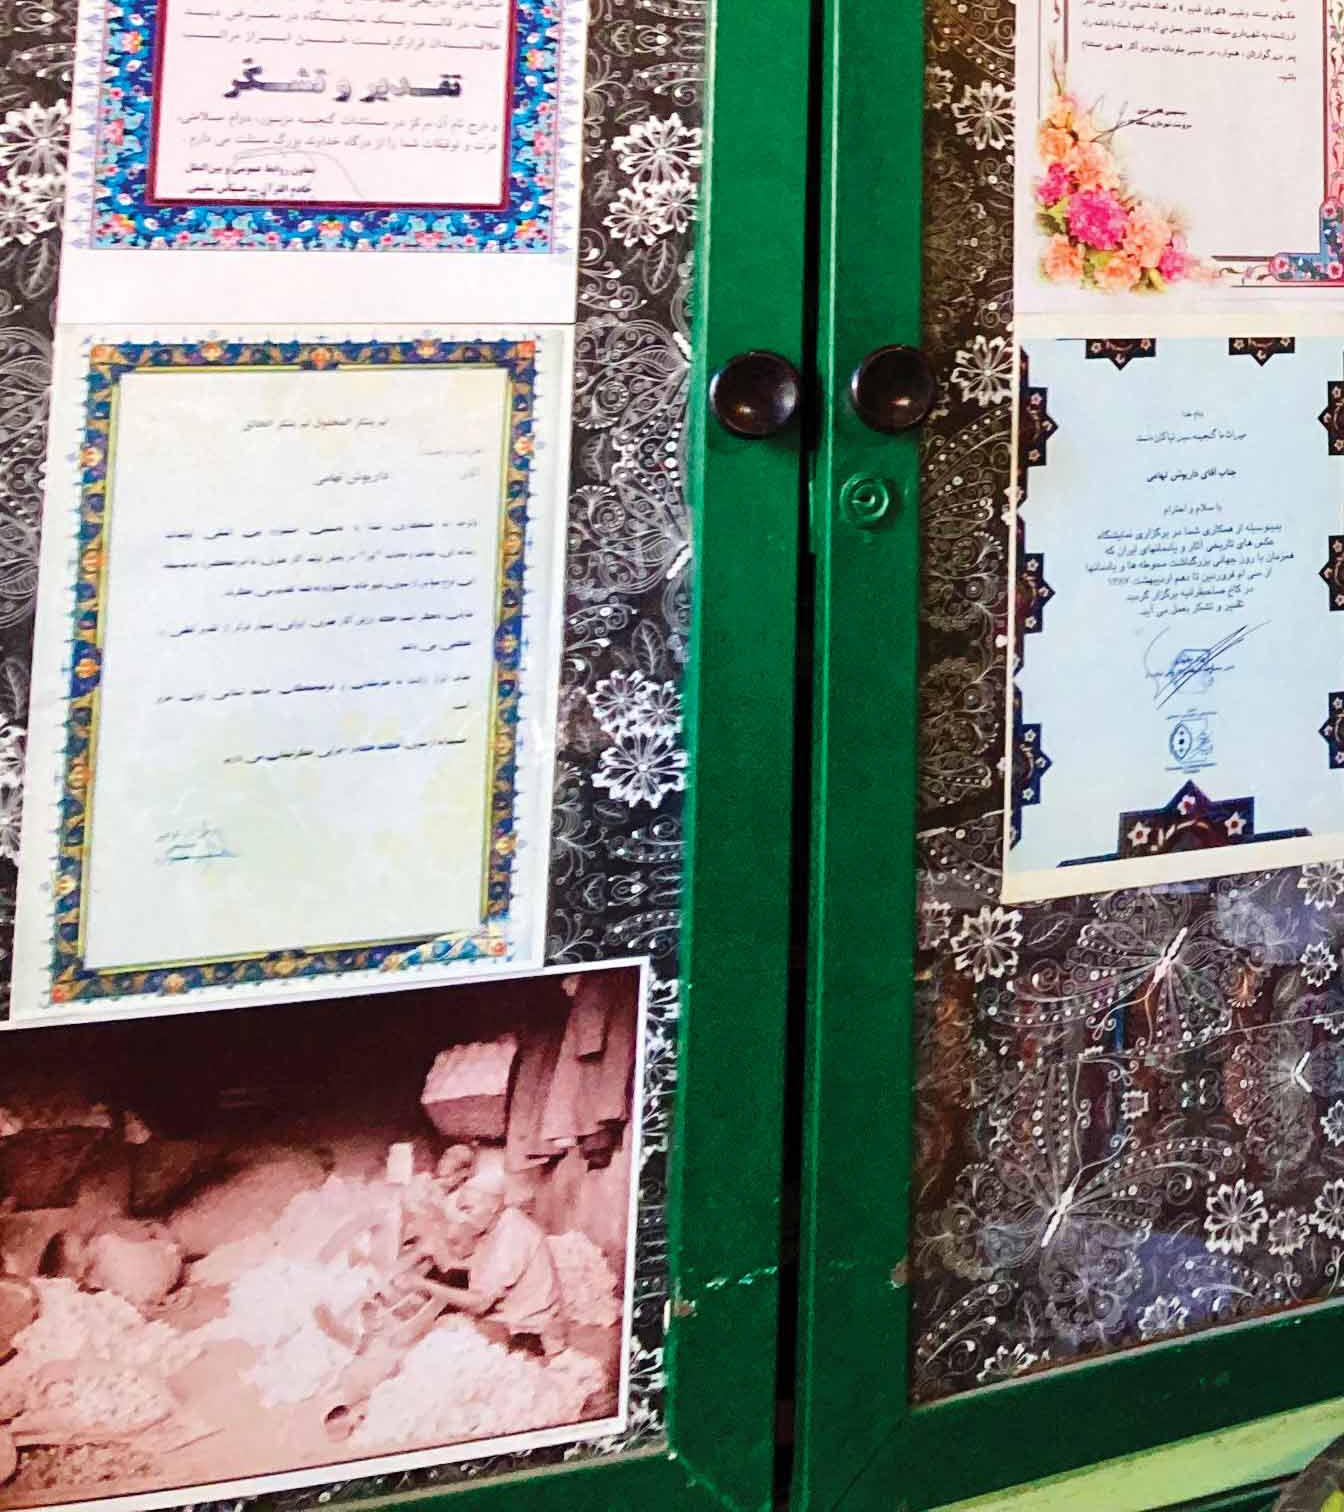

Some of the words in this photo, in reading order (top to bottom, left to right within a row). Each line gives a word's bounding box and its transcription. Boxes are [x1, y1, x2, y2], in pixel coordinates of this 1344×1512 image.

[332, 79, 353, 104] و
[358, 72, 463, 104] تقدیر
[1169, 469, 1200, 482] داریوش
